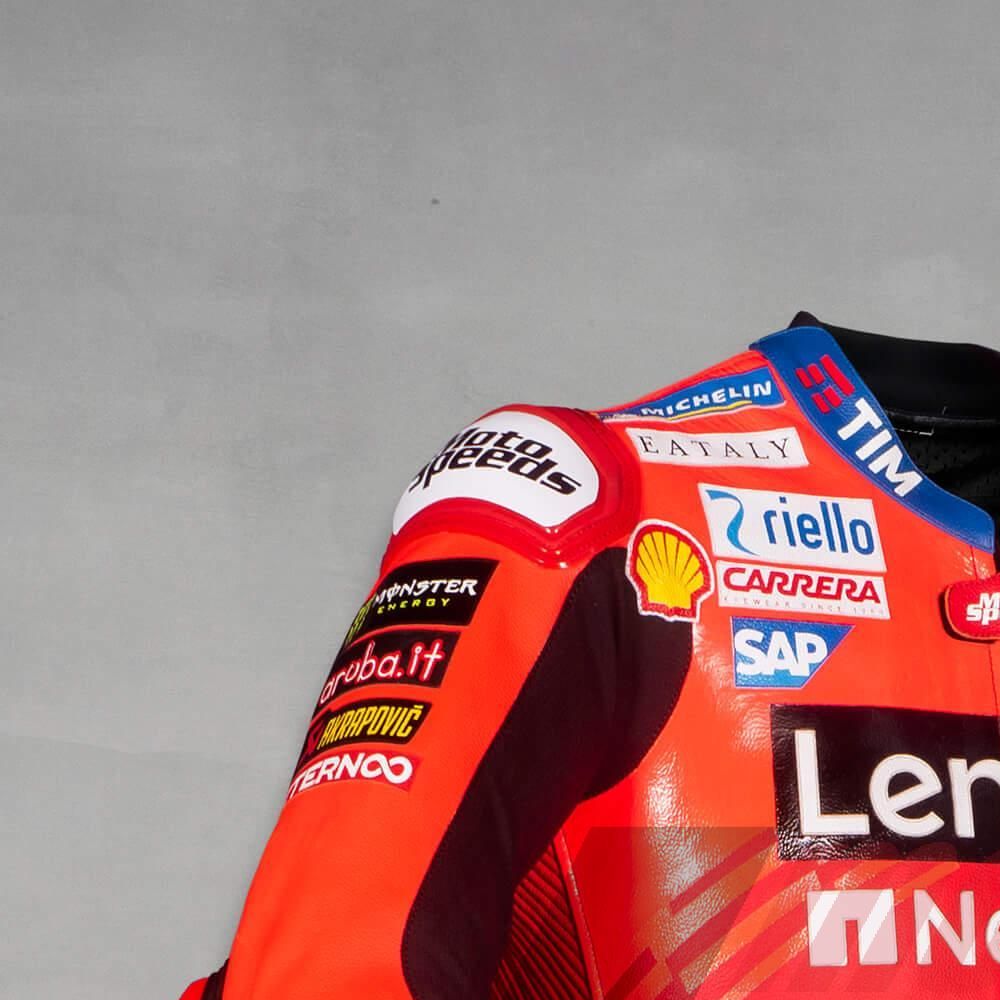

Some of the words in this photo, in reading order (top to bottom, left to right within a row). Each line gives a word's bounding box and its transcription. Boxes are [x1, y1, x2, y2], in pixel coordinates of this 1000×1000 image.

[640, 381, 772, 416] MICHELIN
[638, 433, 792, 460] EATALY
[837, 396, 923, 497] TIM
[762, 496, 876, 556] riello
[377, 597, 451, 615] ENERGY
[722, 567, 881, 604] CARRERA
[319, 640, 443, 705] aruba.it
[734, 628, 828, 677] SAP
